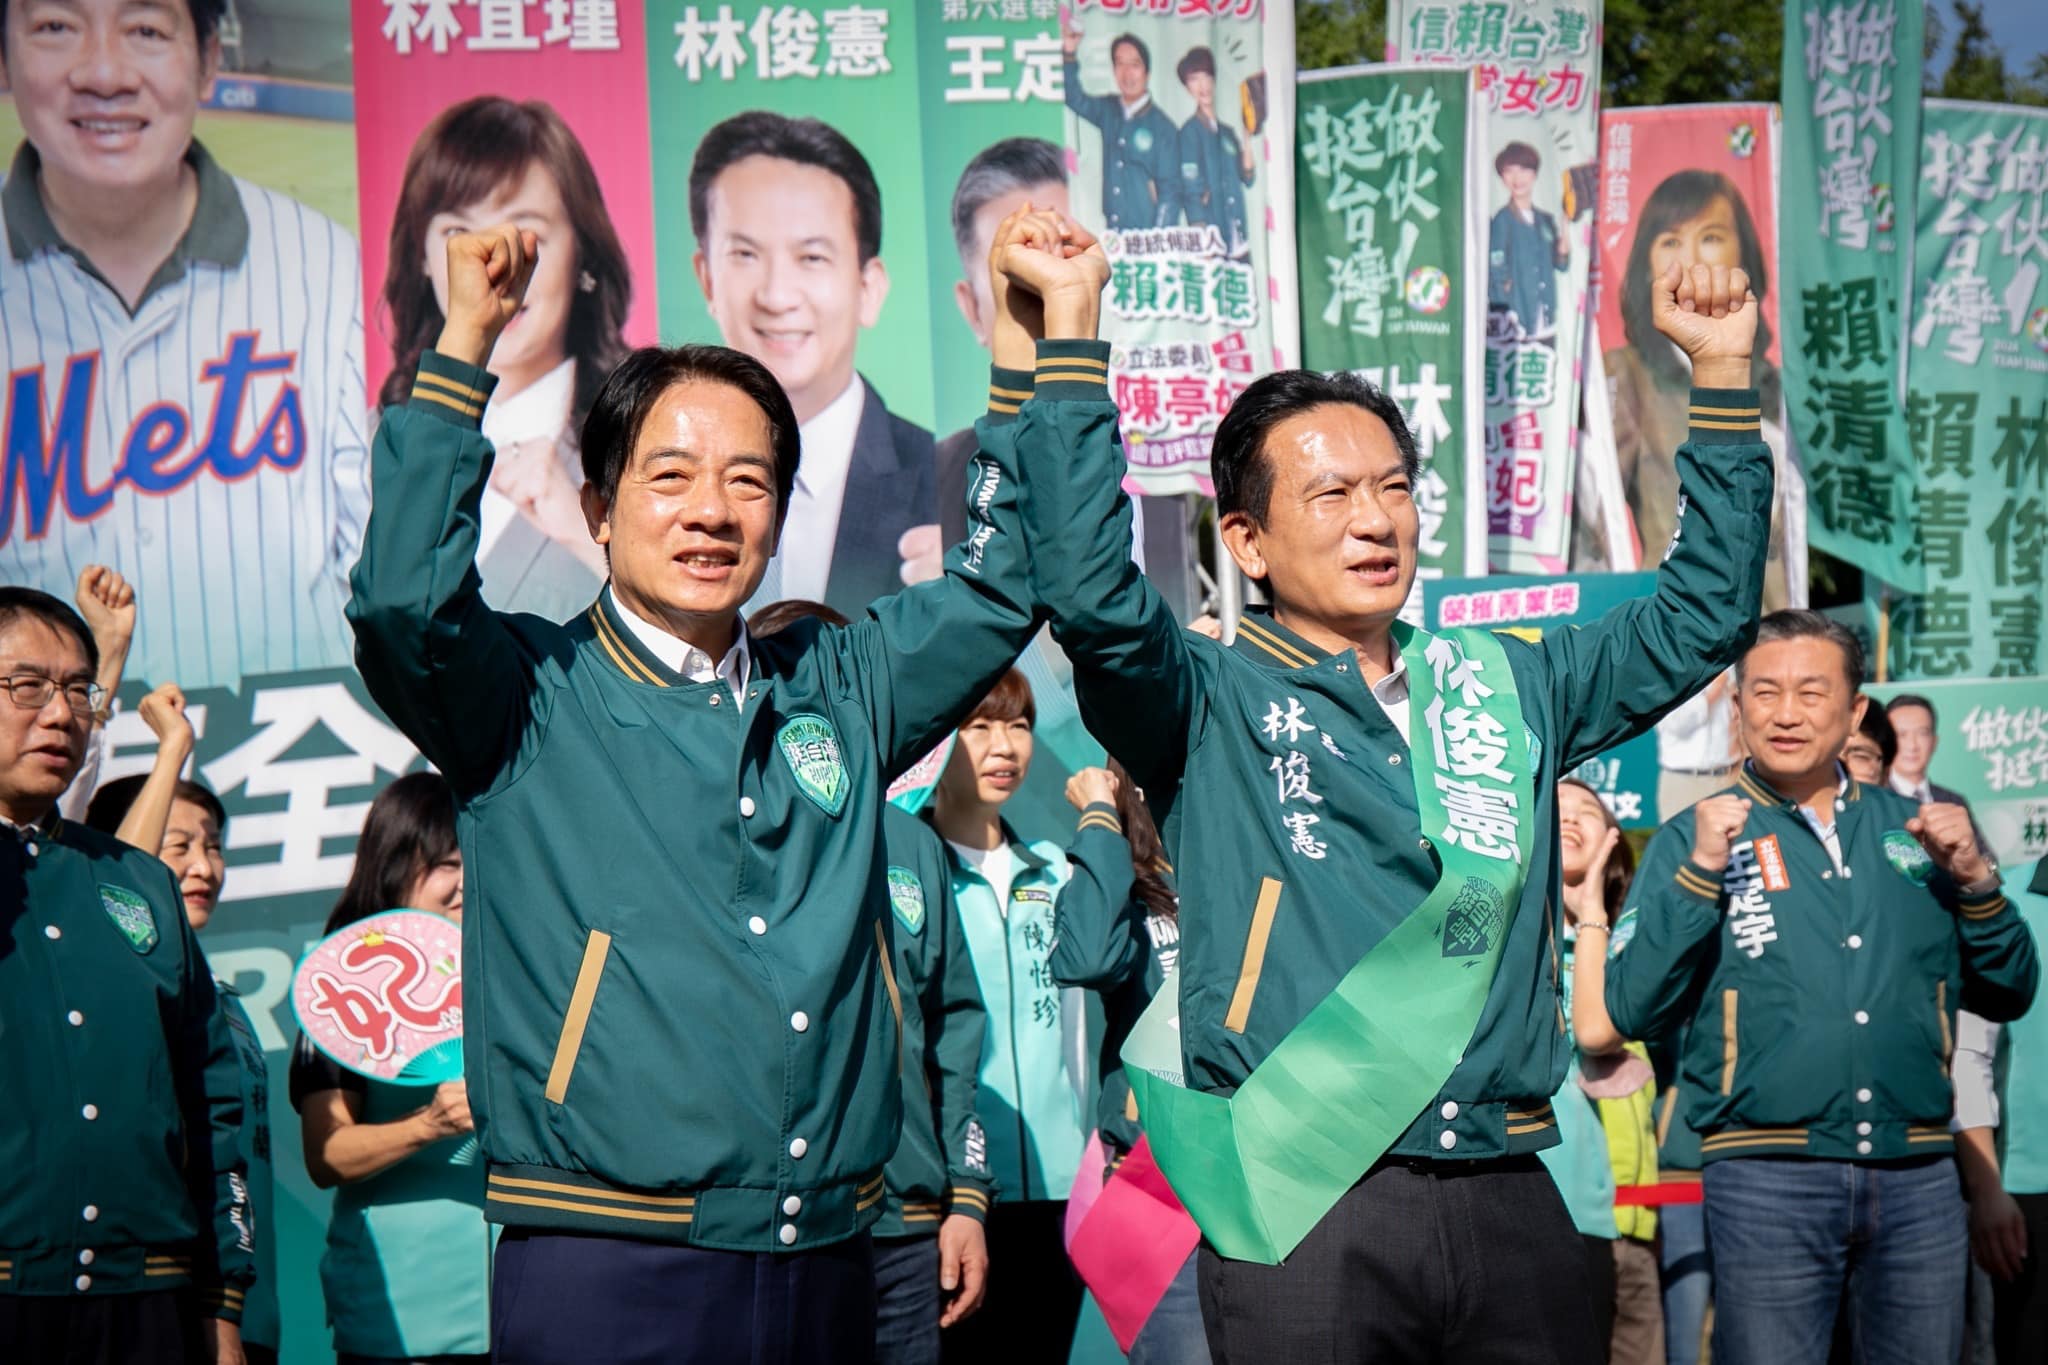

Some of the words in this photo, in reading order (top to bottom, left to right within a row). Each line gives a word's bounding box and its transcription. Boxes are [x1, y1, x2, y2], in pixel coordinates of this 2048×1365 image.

[673, 5, 892, 81] 林俊憲
[1408, 2, 1588, 60] 信賴台灣
[1110, 259, 1252, 320] 賴清德
[0, 329, 307, 550] Mets
[1801, 276, 1897, 546] 賴清德
[971, 525, 997, 566] TEAM
[1888, 388, 1981, 678] 賴清德
[1262, 697, 1327, 860] 林俊憲
[1424, 635, 1522, 864] 林俊憲
